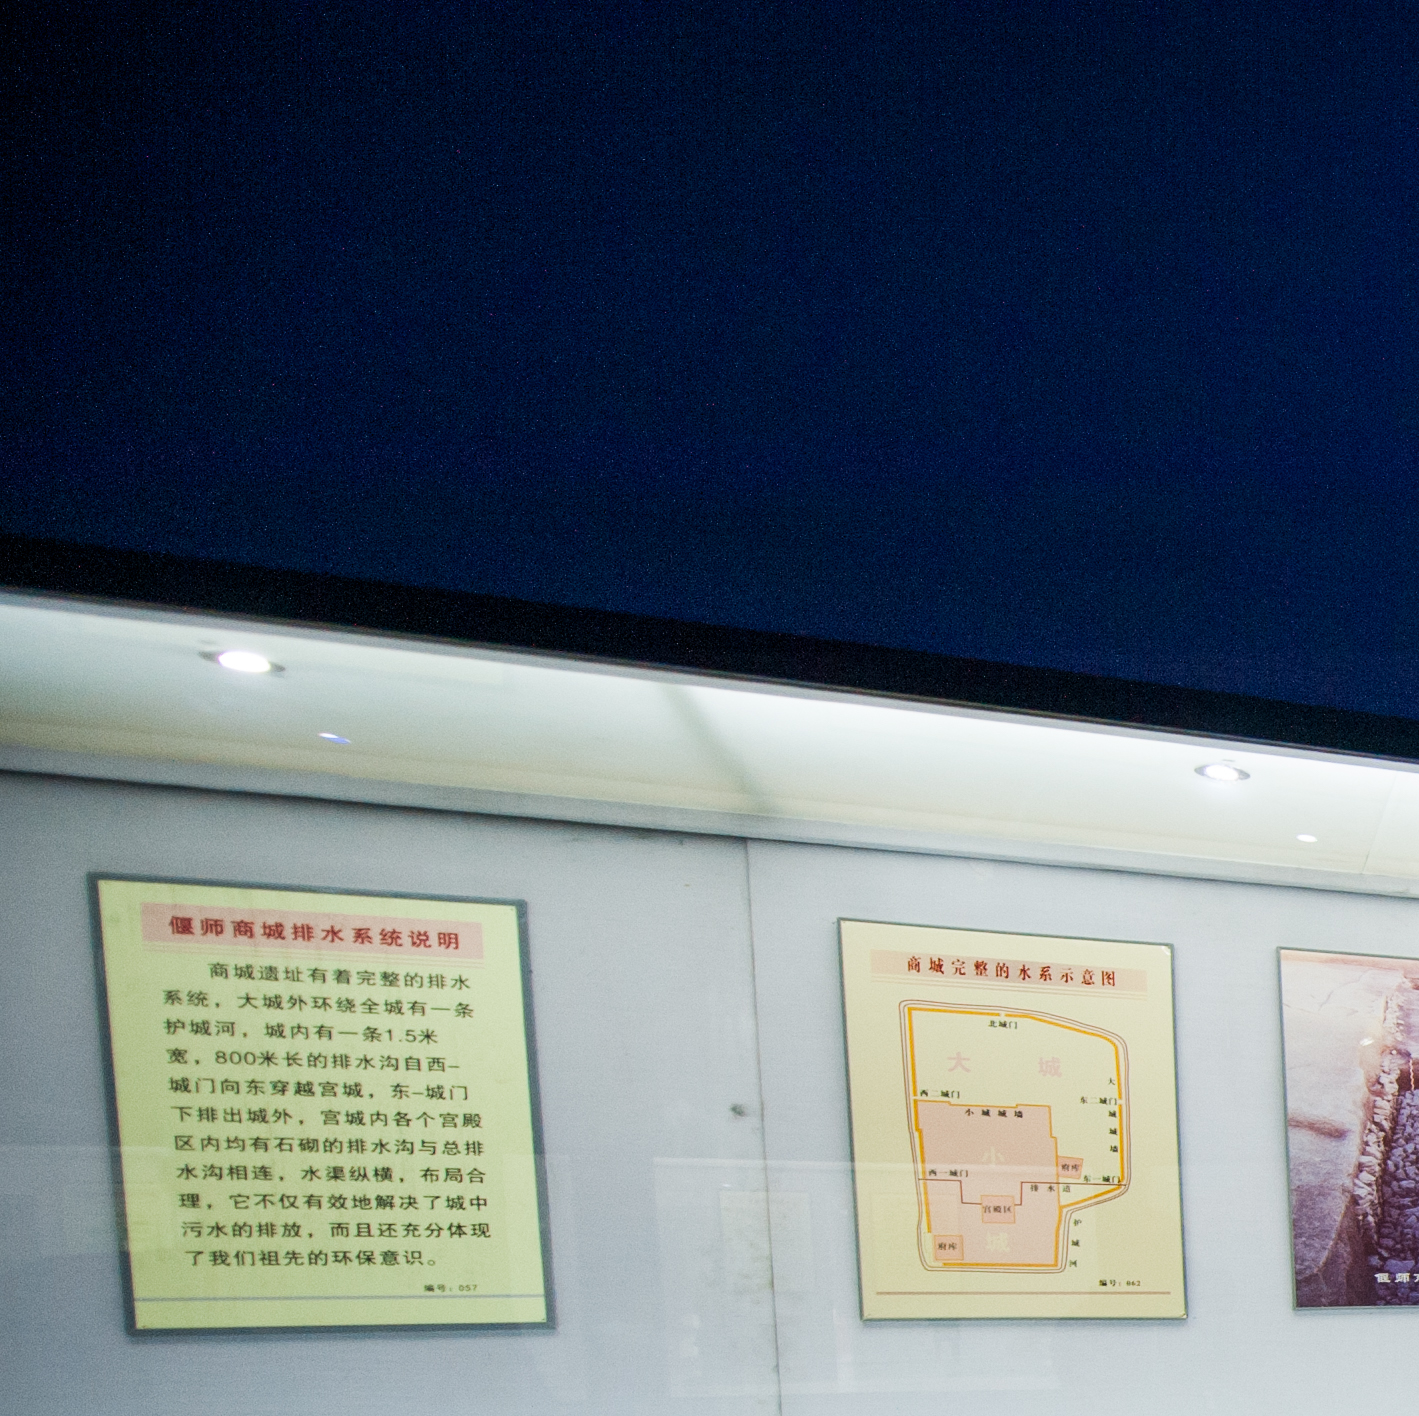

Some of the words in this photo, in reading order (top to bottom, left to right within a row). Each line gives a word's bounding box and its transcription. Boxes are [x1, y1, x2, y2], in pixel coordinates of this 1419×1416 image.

[168, 914, 461, 950] 偃师商城排水系统说明
[208, 962, 471, 991] 商城遗址有着完整的排水
[906, 955, 1117, 987] 商城完整的水系示意图
[163, 990, 475, 1019] 系统，大城外环绕全城有一条
[163, 1019, 439, 1046] 护城河，城内有一条1.5米
[988, 1020, 1018, 1030] 北城门
[171, 1105, 483, 1130] 下排出城外，宫城内各个宫殿
[173, 1134, 485, 1157] 区内均有石砌的排水沟与总排
[176, 1163, 487, 1184] 水沟相连，水渠纵横，布局合
[178, 1192, 488, 1212] 理，它不仅有效地解决了城中
[181, 1220, 492, 1240] 污水的排放，而且还充分体现
[185, 1249, 438, 1268] 了我们祖先的环保意识。
